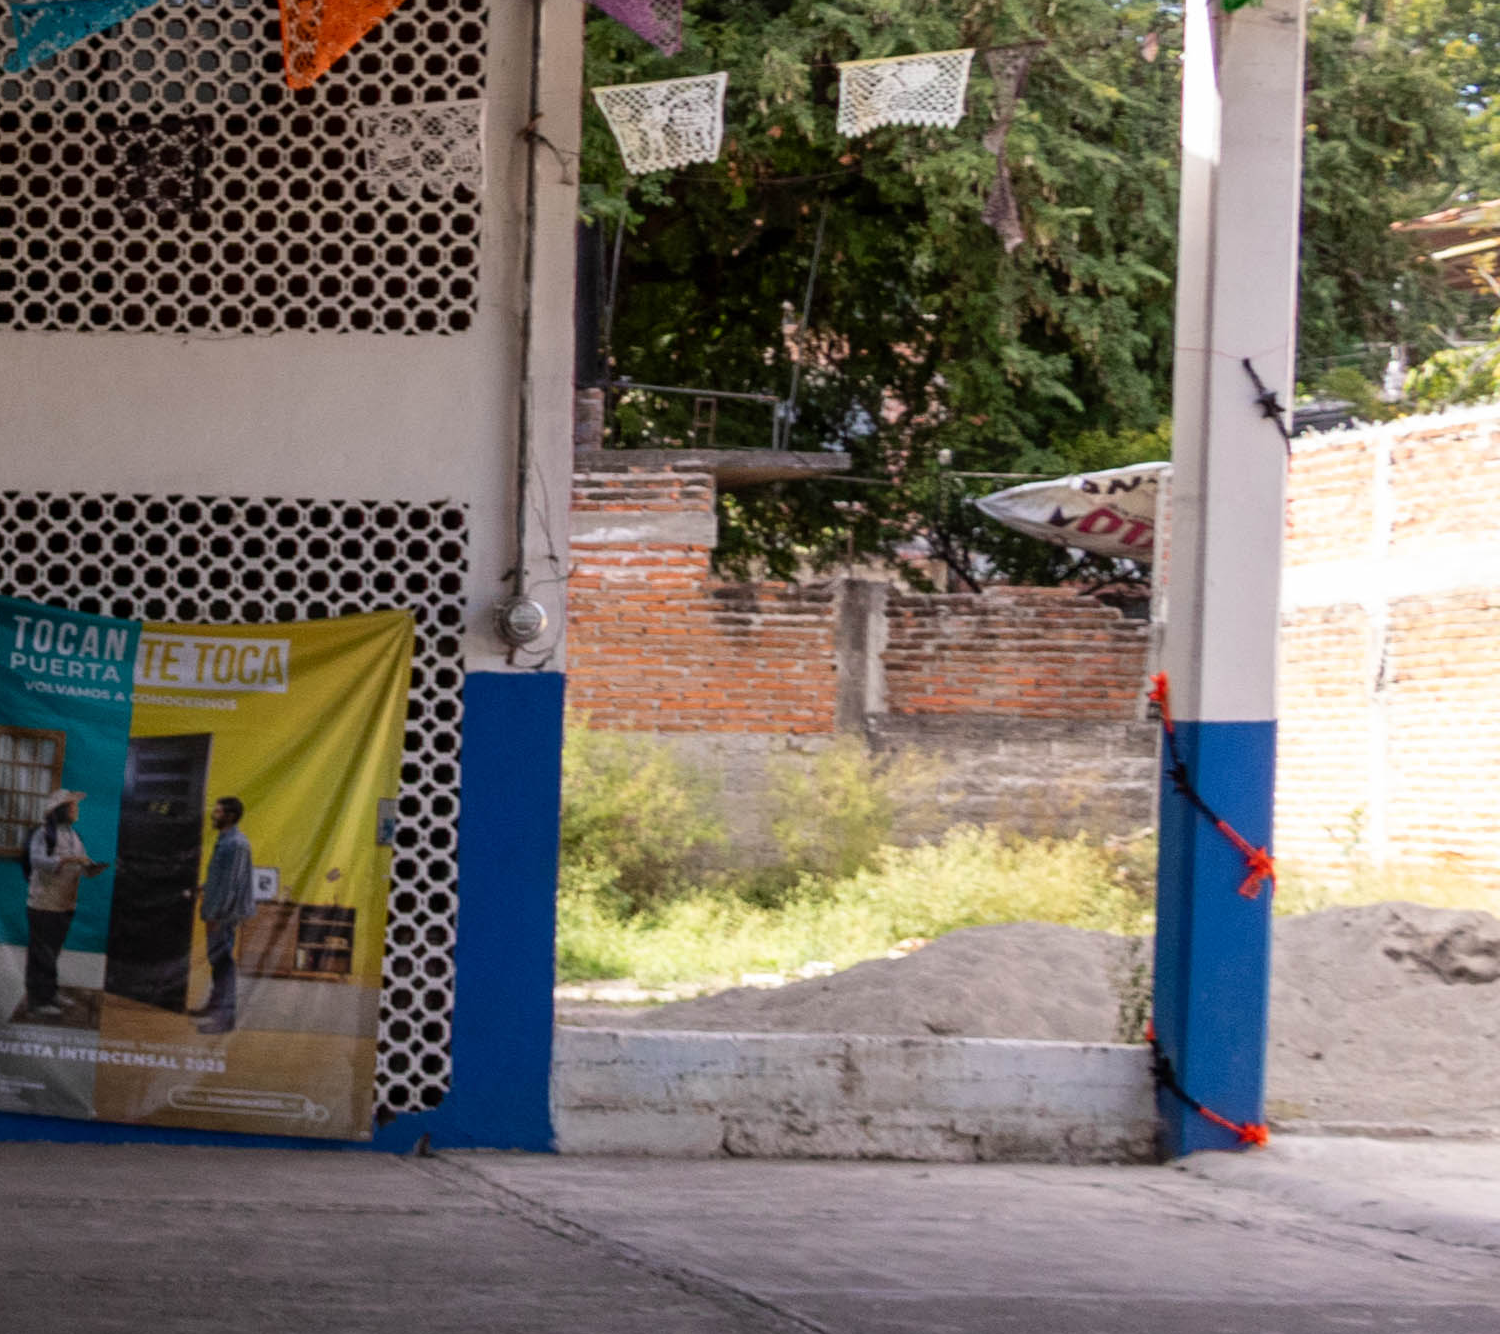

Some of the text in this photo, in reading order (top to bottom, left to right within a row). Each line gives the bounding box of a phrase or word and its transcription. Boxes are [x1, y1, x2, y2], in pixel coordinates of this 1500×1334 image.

[13, 614, 130, 663] TOCAN
[9, 652, 121, 685] PUERTA
[140, 637, 285, 685] TE TOCA
[24, 680, 238, 712] VOLVAMOS A CONOCERNOS
[58, 1045, 181, 1070] INTERCENSAL
